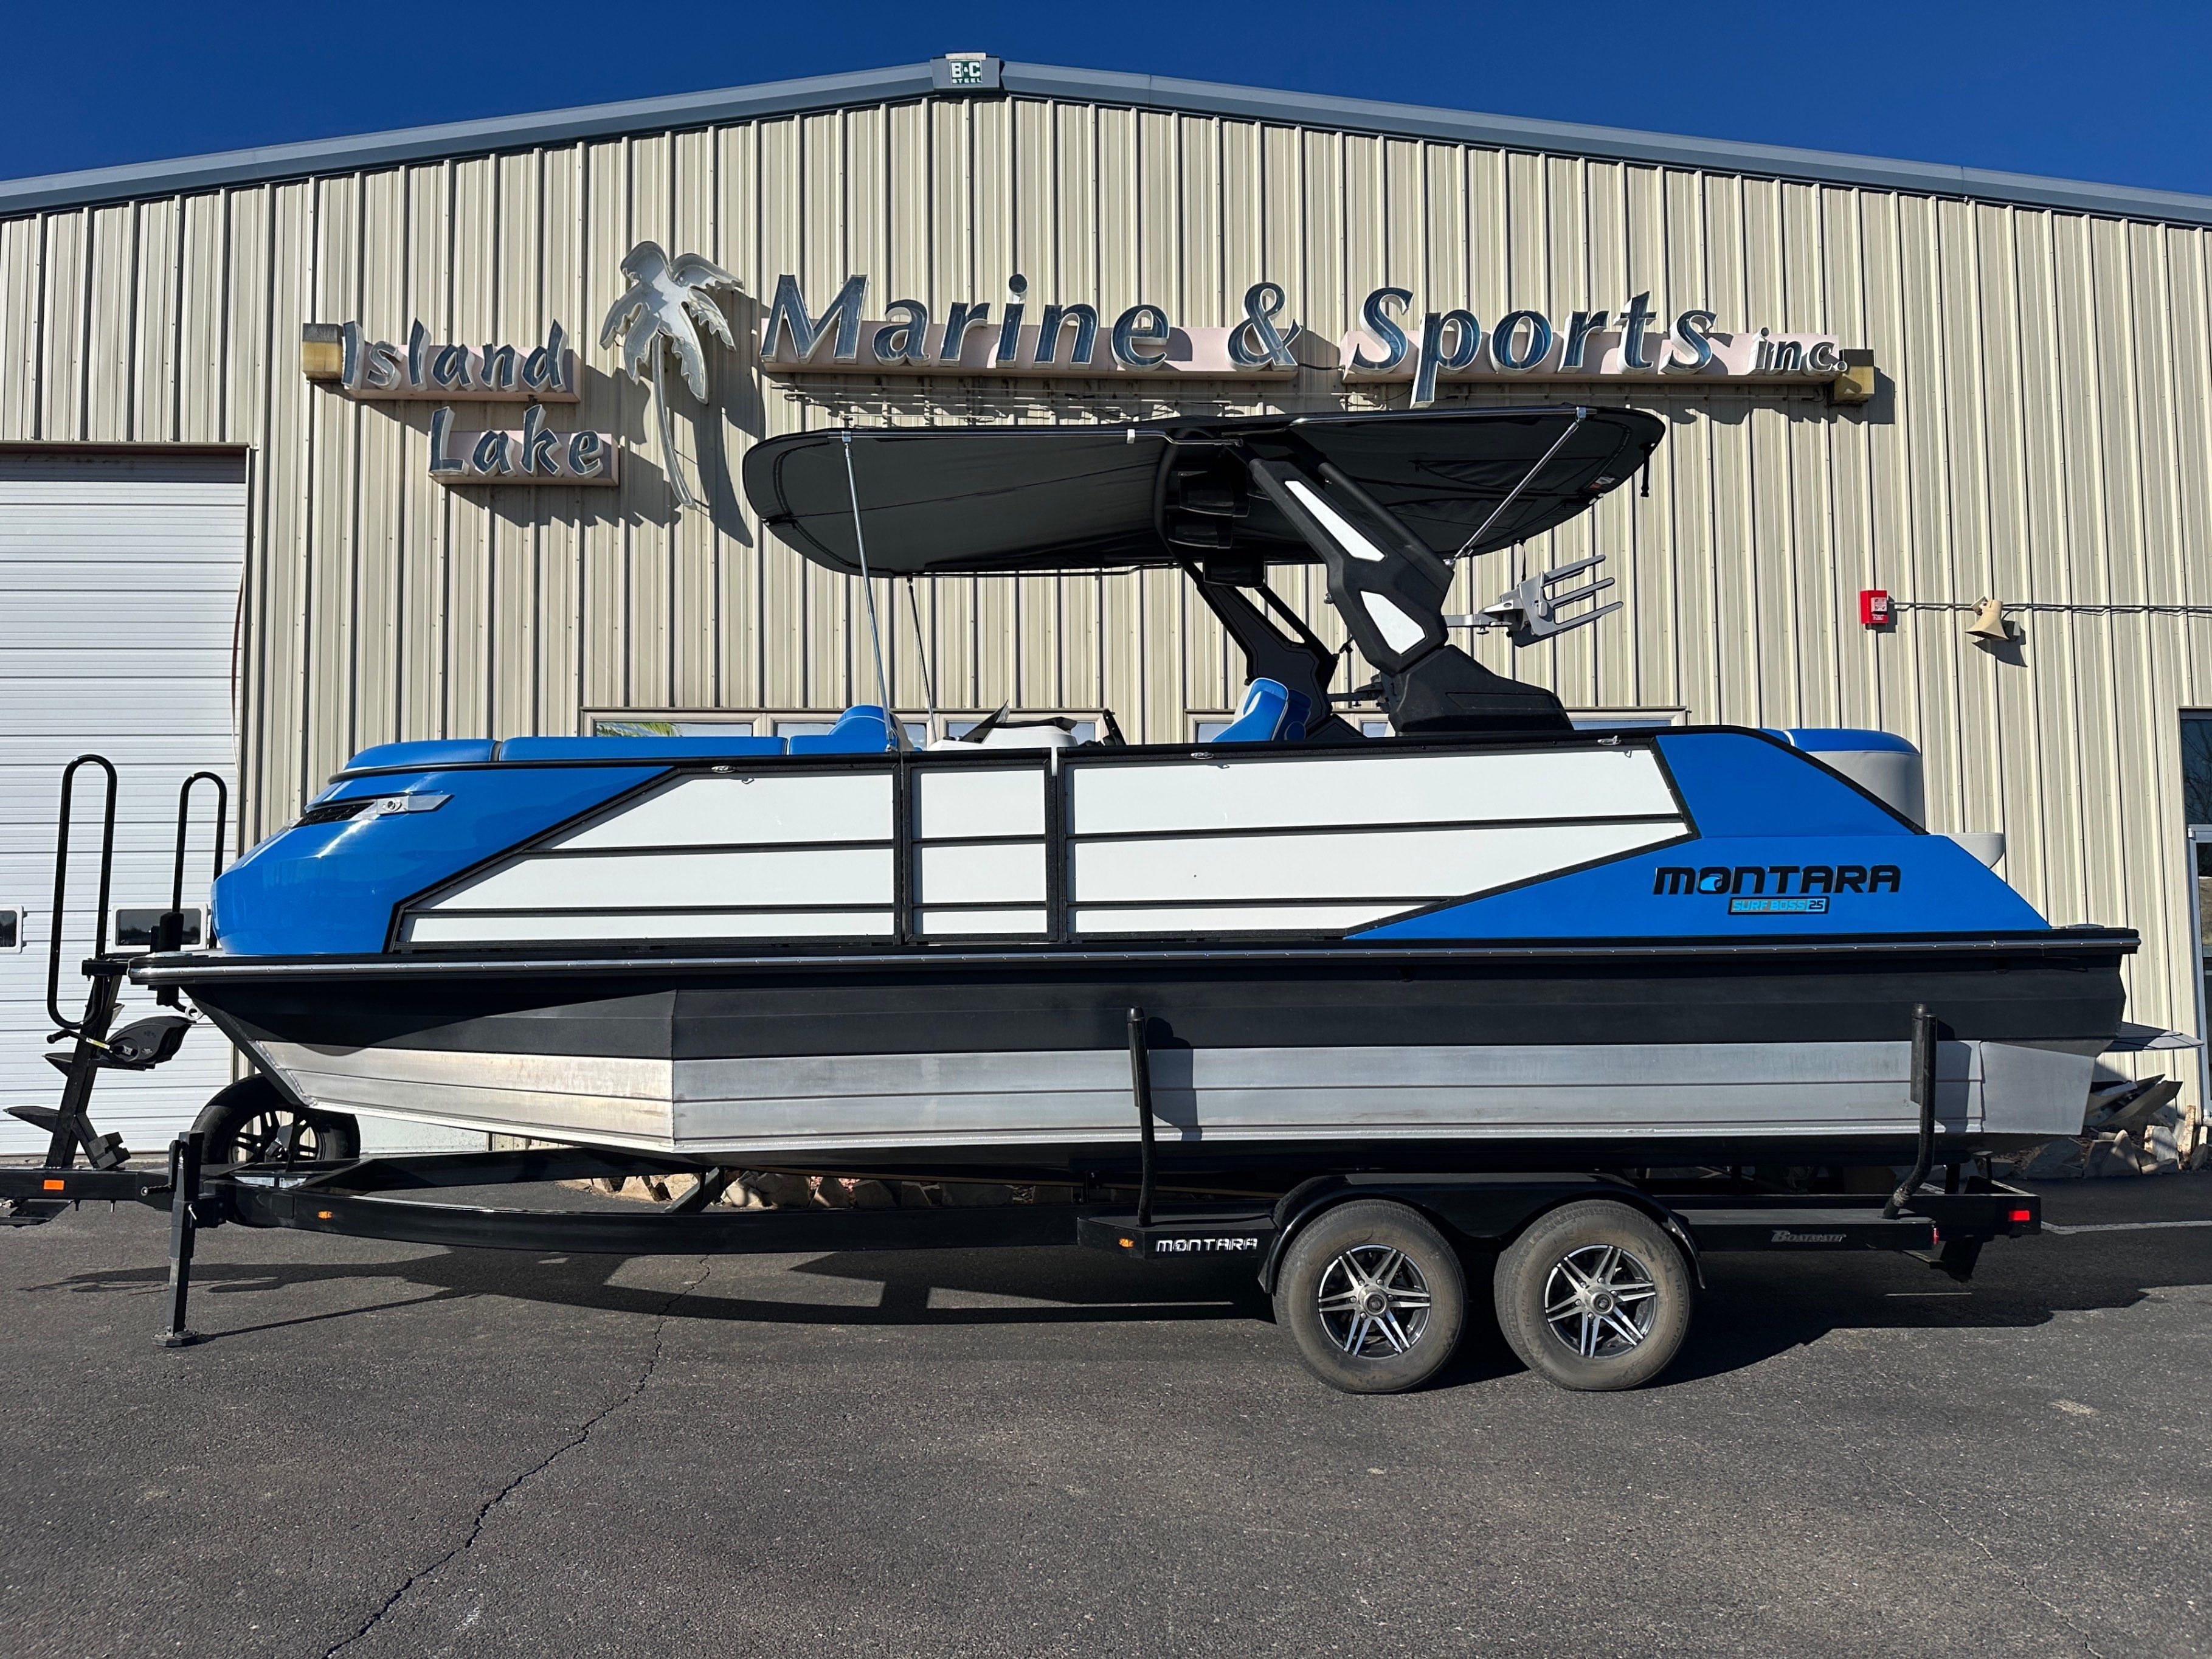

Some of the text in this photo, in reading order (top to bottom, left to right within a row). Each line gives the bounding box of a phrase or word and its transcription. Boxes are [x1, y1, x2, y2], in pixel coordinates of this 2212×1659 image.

[342, 318, 567, 392] Island
[760, 273, 1848, 408] Marine & Sports inc.
[429, 404, 603, 478] Lake
[1653, 865, 1901, 895] MONTARA
[1732, 899, 1824, 912] SURF BOSS 25
[1156, 1238, 1257, 1252] MONTARA
